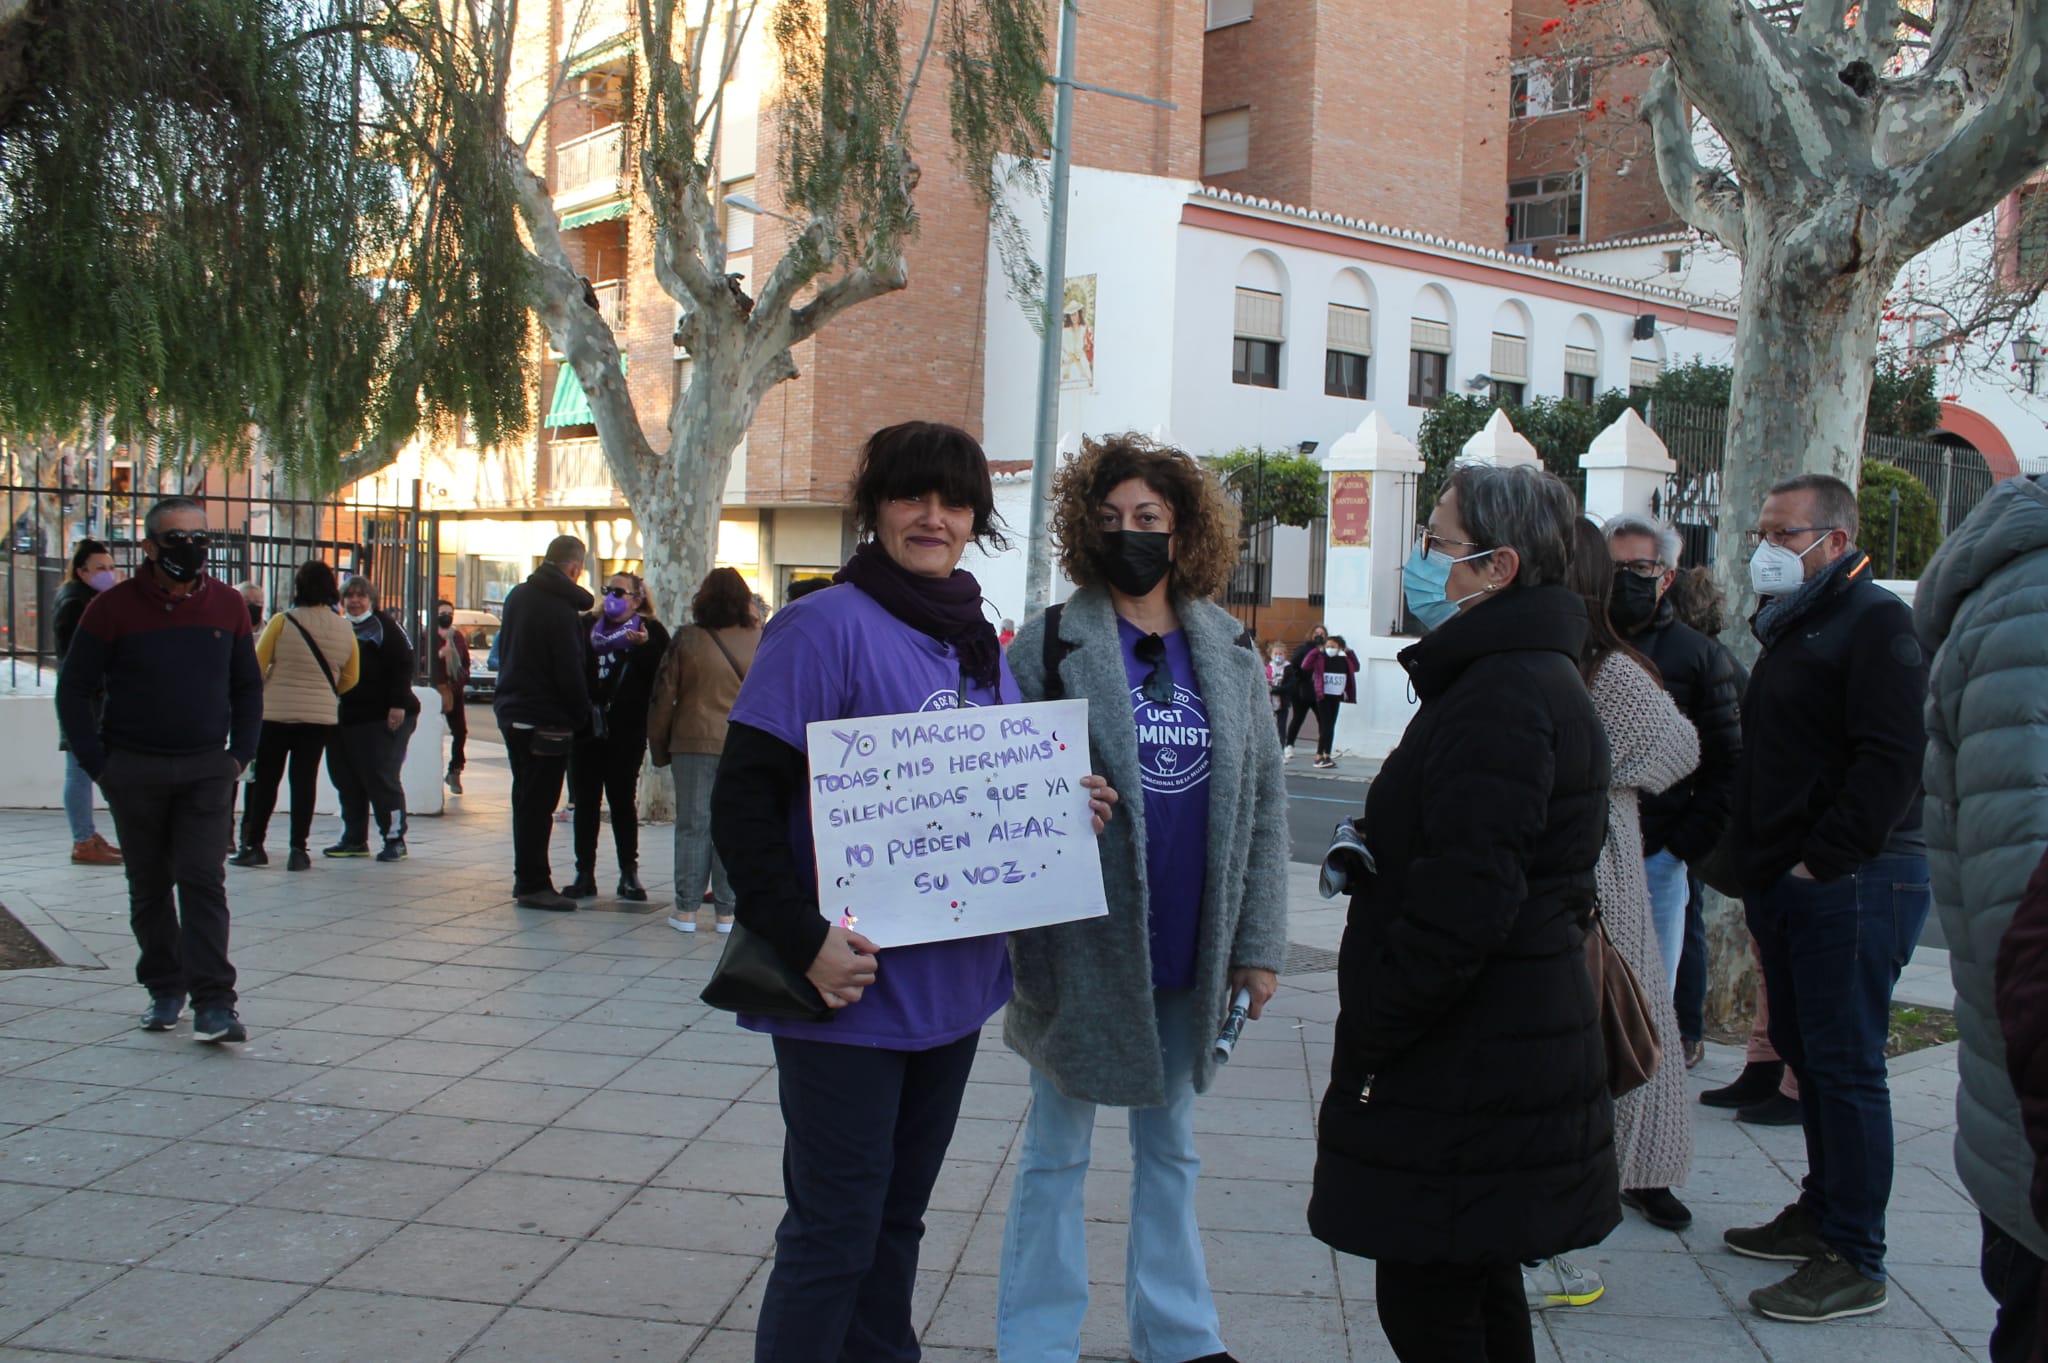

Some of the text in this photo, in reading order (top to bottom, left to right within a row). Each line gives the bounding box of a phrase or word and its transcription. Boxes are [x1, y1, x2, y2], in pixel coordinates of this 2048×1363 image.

[1146, 708, 1183, 723] UGT
[832, 717, 1040, 768] YO MARCHO POR
[813, 740, 1053, 794] TODAS MIS HERMANAS
[1044, 777, 1070, 798] YA
[846, 844, 874, 868] NO
[888, 832, 971, 865] PUEDEN
[914, 860, 1038, 894] SU VOZ.
